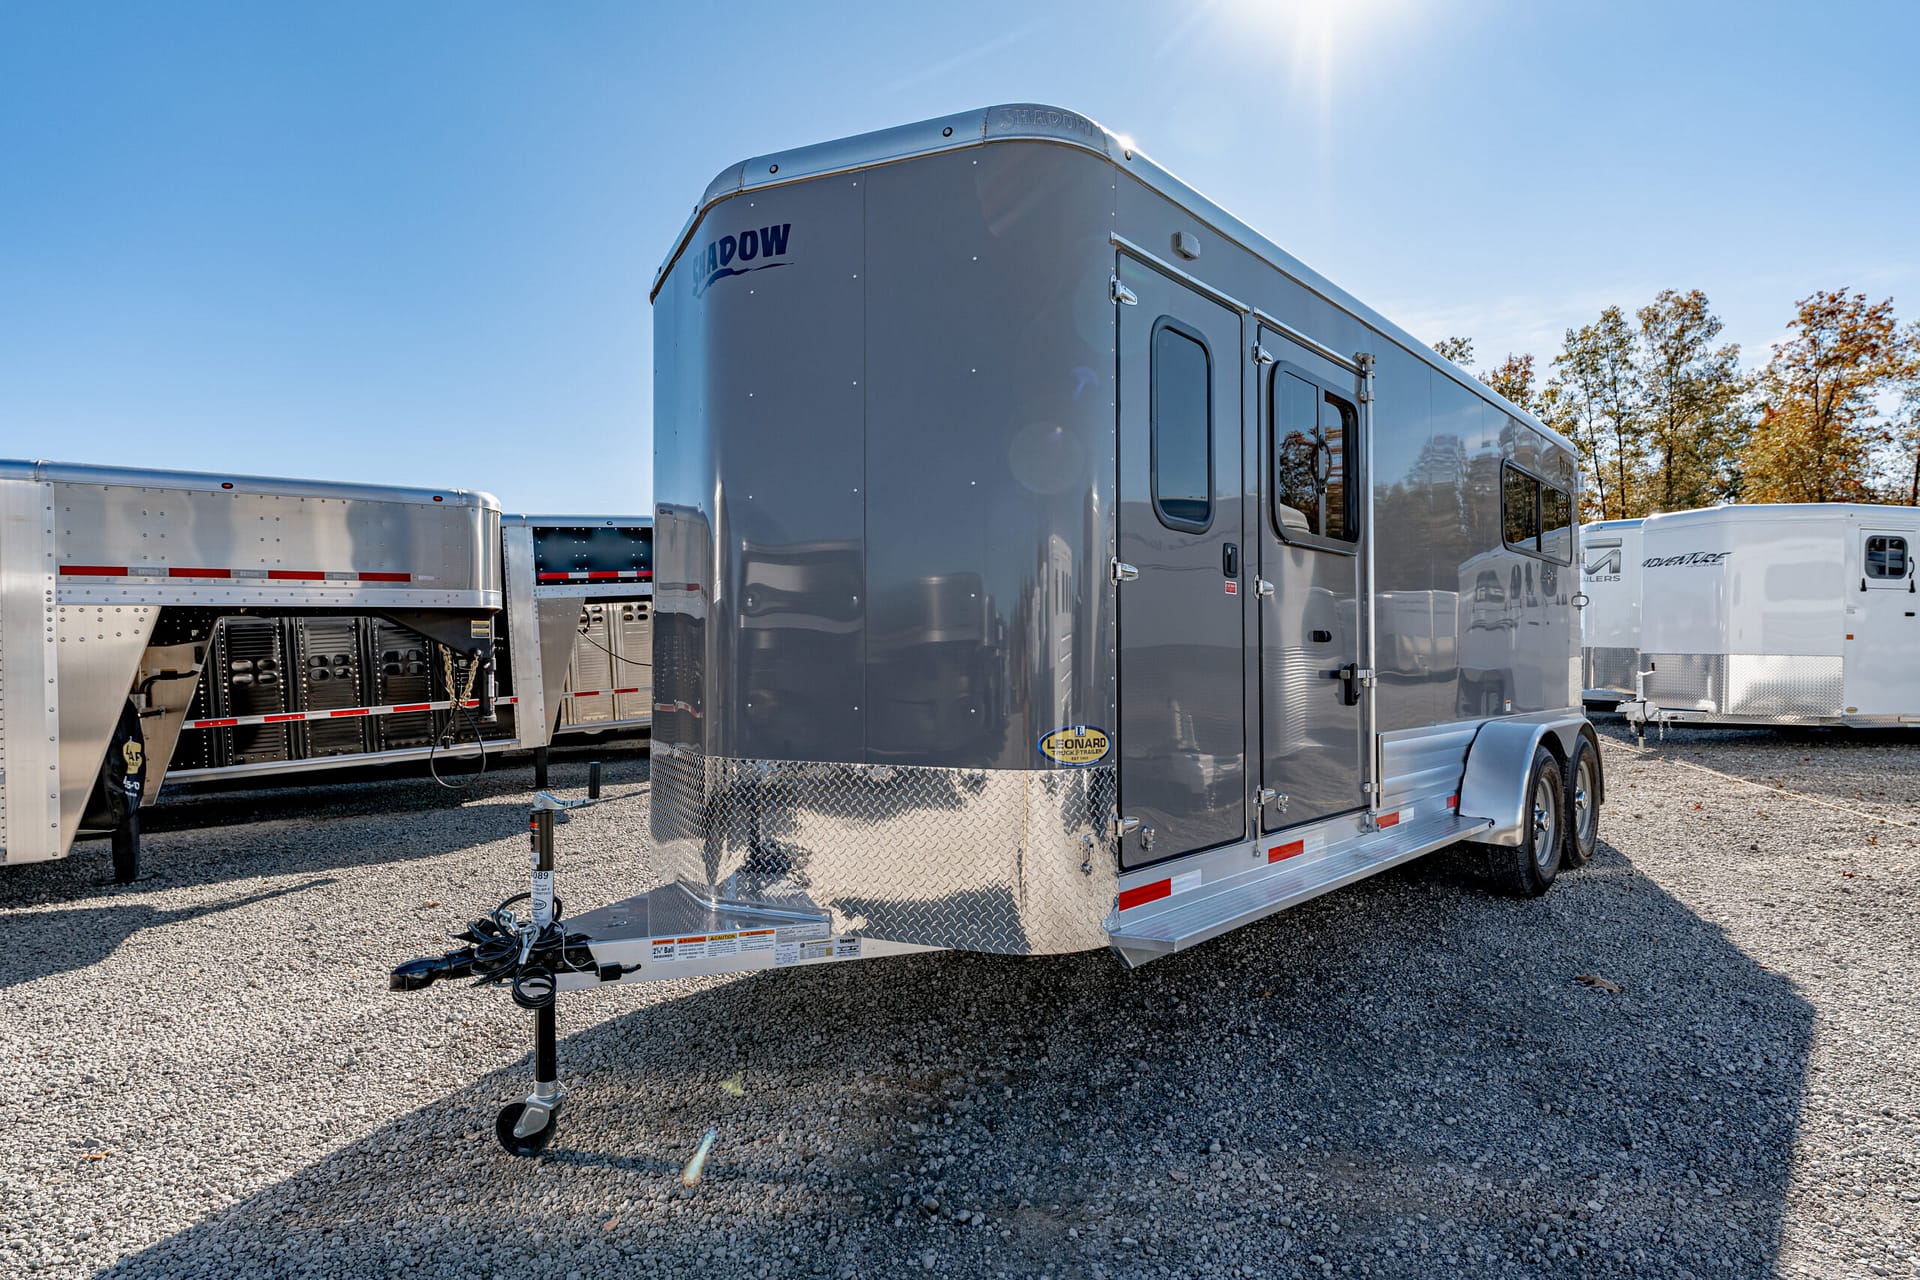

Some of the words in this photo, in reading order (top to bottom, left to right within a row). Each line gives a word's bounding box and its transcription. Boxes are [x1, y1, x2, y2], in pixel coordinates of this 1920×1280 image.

[1000, 108, 1094, 137] SHADOW
[692, 223, 792, 297] SHADOW
[1641, 551, 1732, 568] ADVENTURE
[1047, 738, 1106, 749] LEONARD
